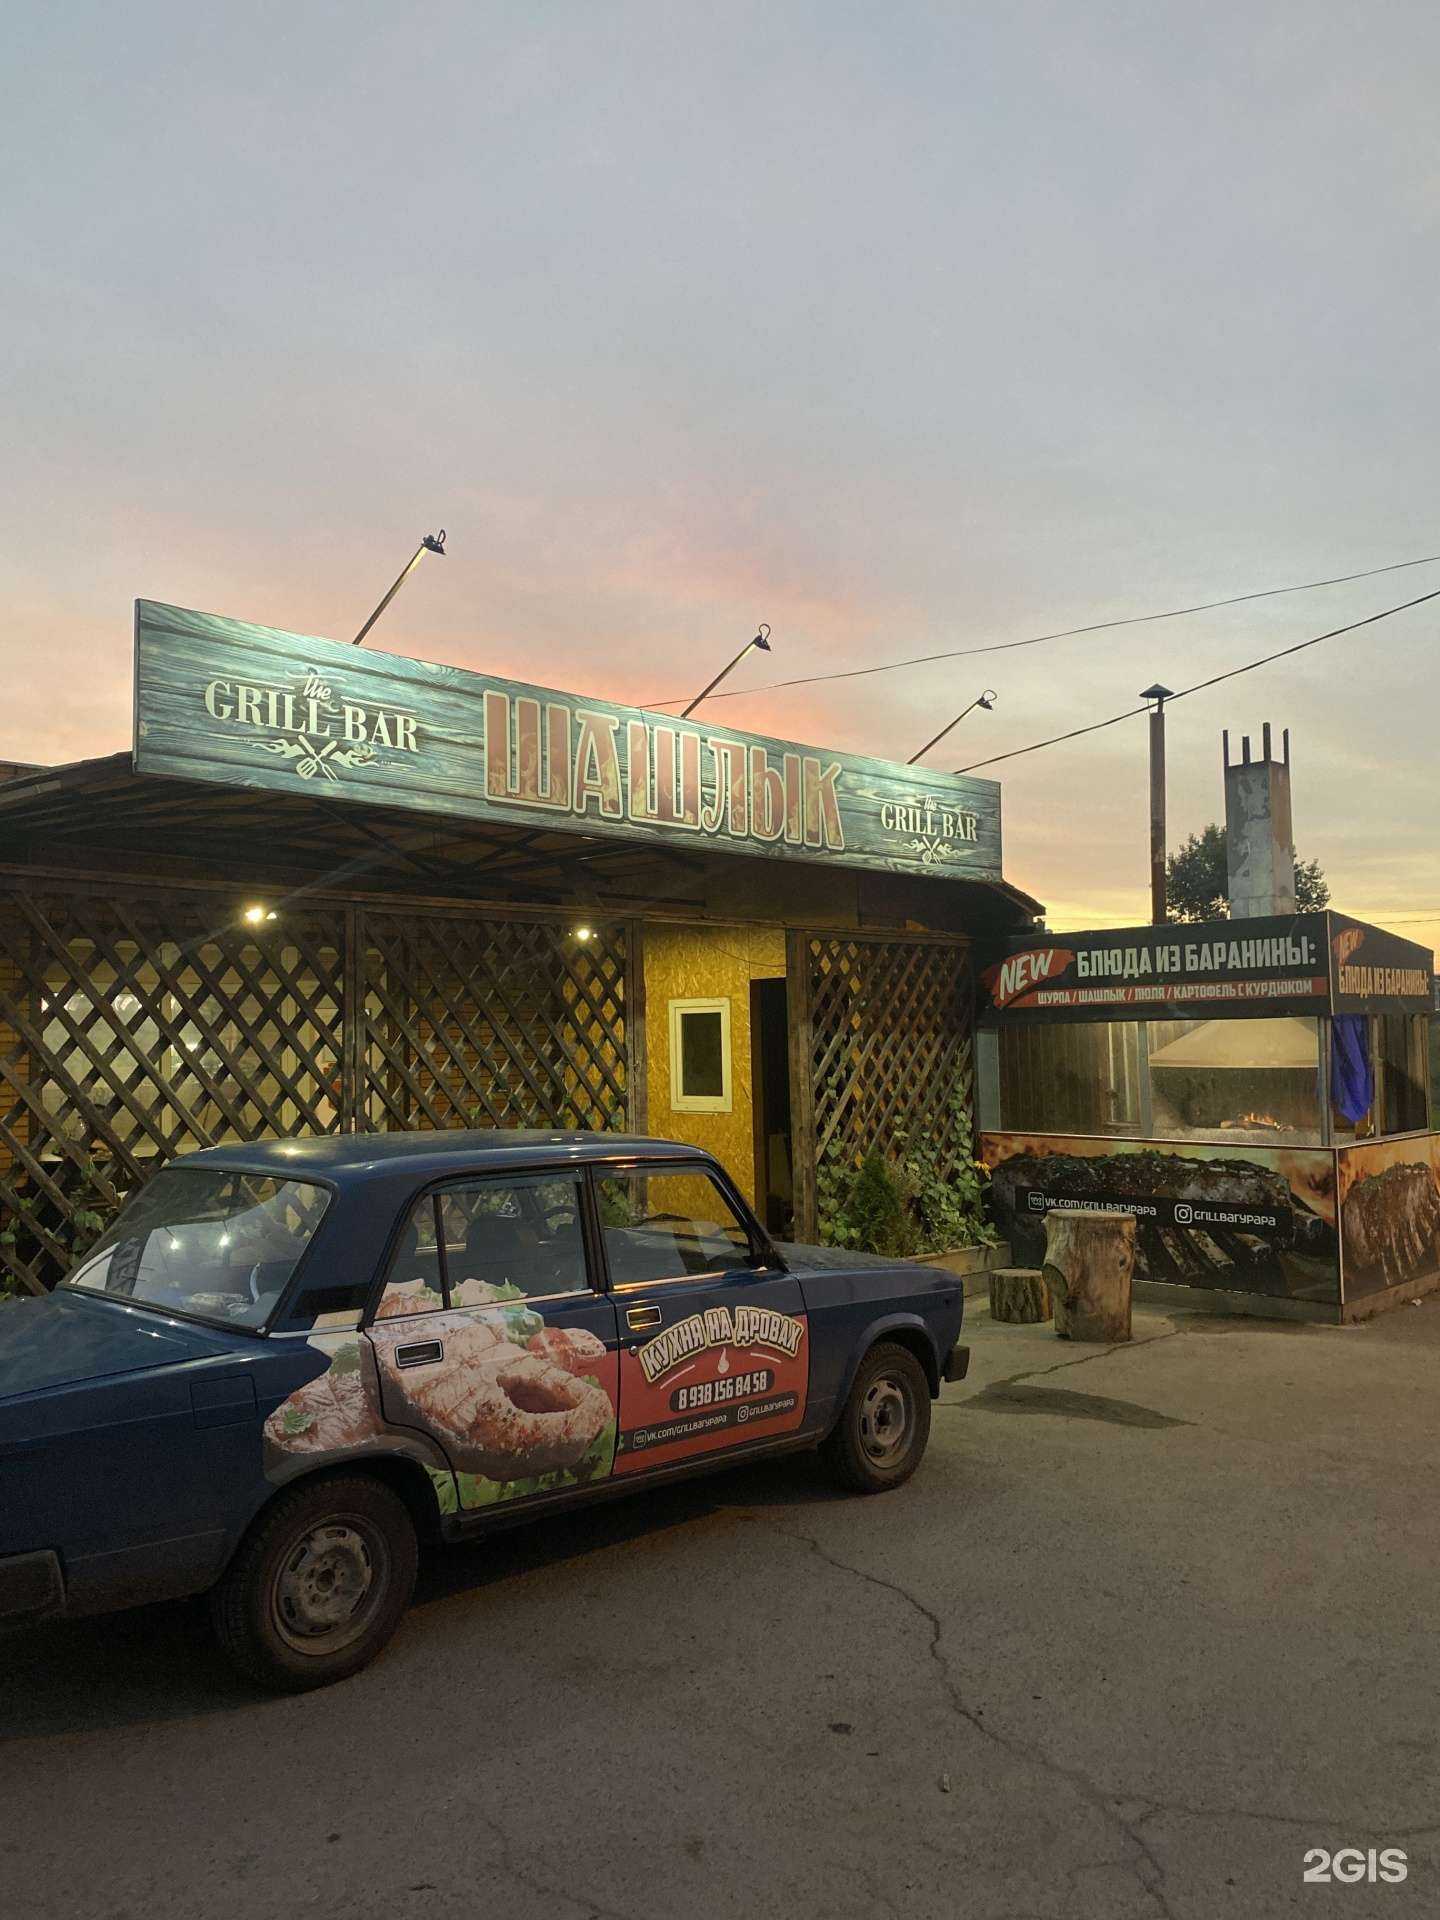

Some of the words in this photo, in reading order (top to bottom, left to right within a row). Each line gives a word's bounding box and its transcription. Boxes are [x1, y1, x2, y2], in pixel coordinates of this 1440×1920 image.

[205, 680, 331, 736] GRILL
[343, 704, 419, 753] BAR
[482, 690, 845, 850] ШАШЛЫК
[881, 803, 937, 836] GRILL
[942, 813, 978, 841] BAR
[1000, 949, 1054, 1000] NEW
[1077, 947, 1152, 979] БЛЮДА
[1155, 945, 1181, 973] ИЗ
[1185, 936, 1317, 972] БАРАНИНЫ:
[1038, 990, 1070, 1005] ШУРПА
[1078, 989, 1126, 1002] ШАШЛЫК
[1135, 987, 1165, 1001] ЛЮЛЯ
[1174, 984, 1236, 999] КАРТОФЕЛЬ
[1246, 980, 1312, 997] КУРДЮКОМ
[1339, 966, 1373, 998] БЛЮДА
[1374, 967, 1384, 995] ИЗ
[641, 1315, 705, 1378] КУХНЯ
[705, 1309, 733, 1345] НА
[735, 1308, 803, 1356] ДРОВАХ
[679, 1389, 687, 1410] 8
[690, 1384, 712, 1407] 938
[714, 1378, 733, 1401] 156
[736, 1374, 751, 1397] 84
[753, 1371, 767, 1392] 58
